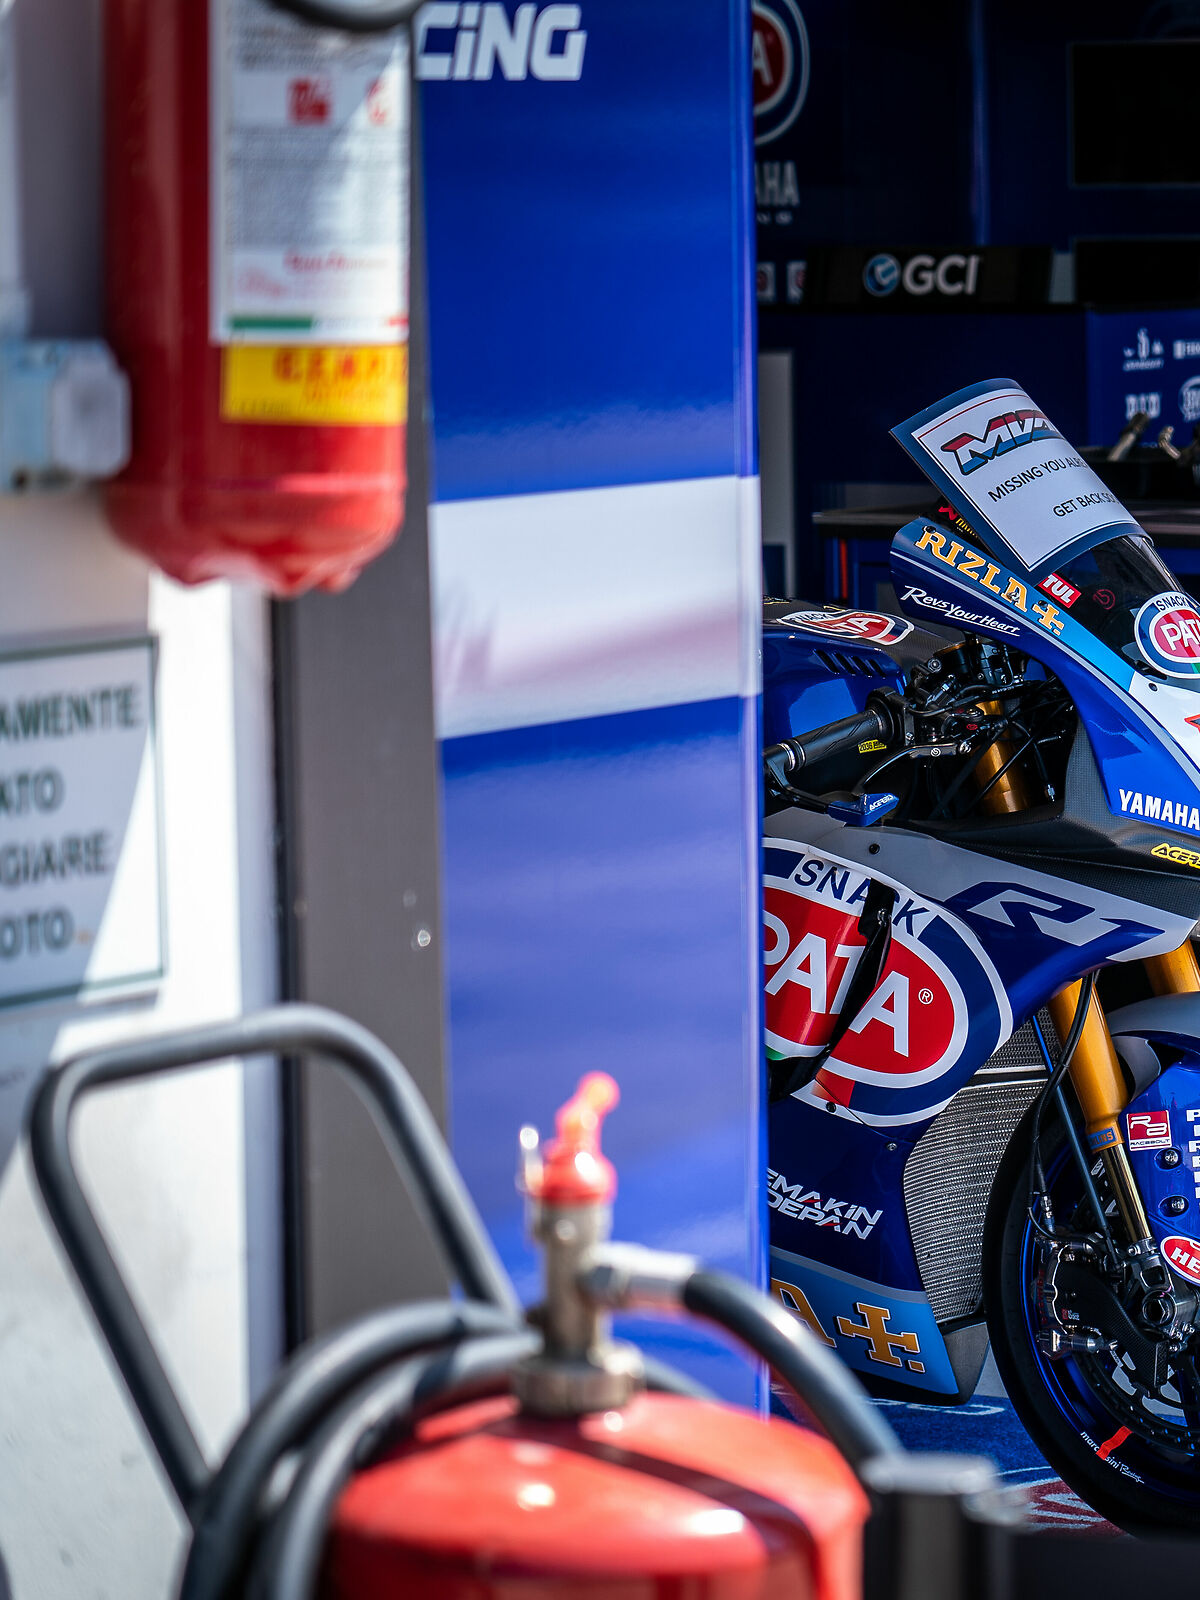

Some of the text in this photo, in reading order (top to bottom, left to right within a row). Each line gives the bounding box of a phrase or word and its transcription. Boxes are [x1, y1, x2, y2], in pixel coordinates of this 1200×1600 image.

[988, 466, 1044, 502] MISSING
[1040, 458, 1067, 474] YOU
[1053, 499, 1079, 517] GET
[1076, 491, 1104, 508] BACK
[1119, 788, 1200, 831] YAMAHA
[795, 859, 929, 936] SNAK
[767, 1188, 874, 1240] DEPAN
[1080, 1431, 1121, 1470] marcsini
